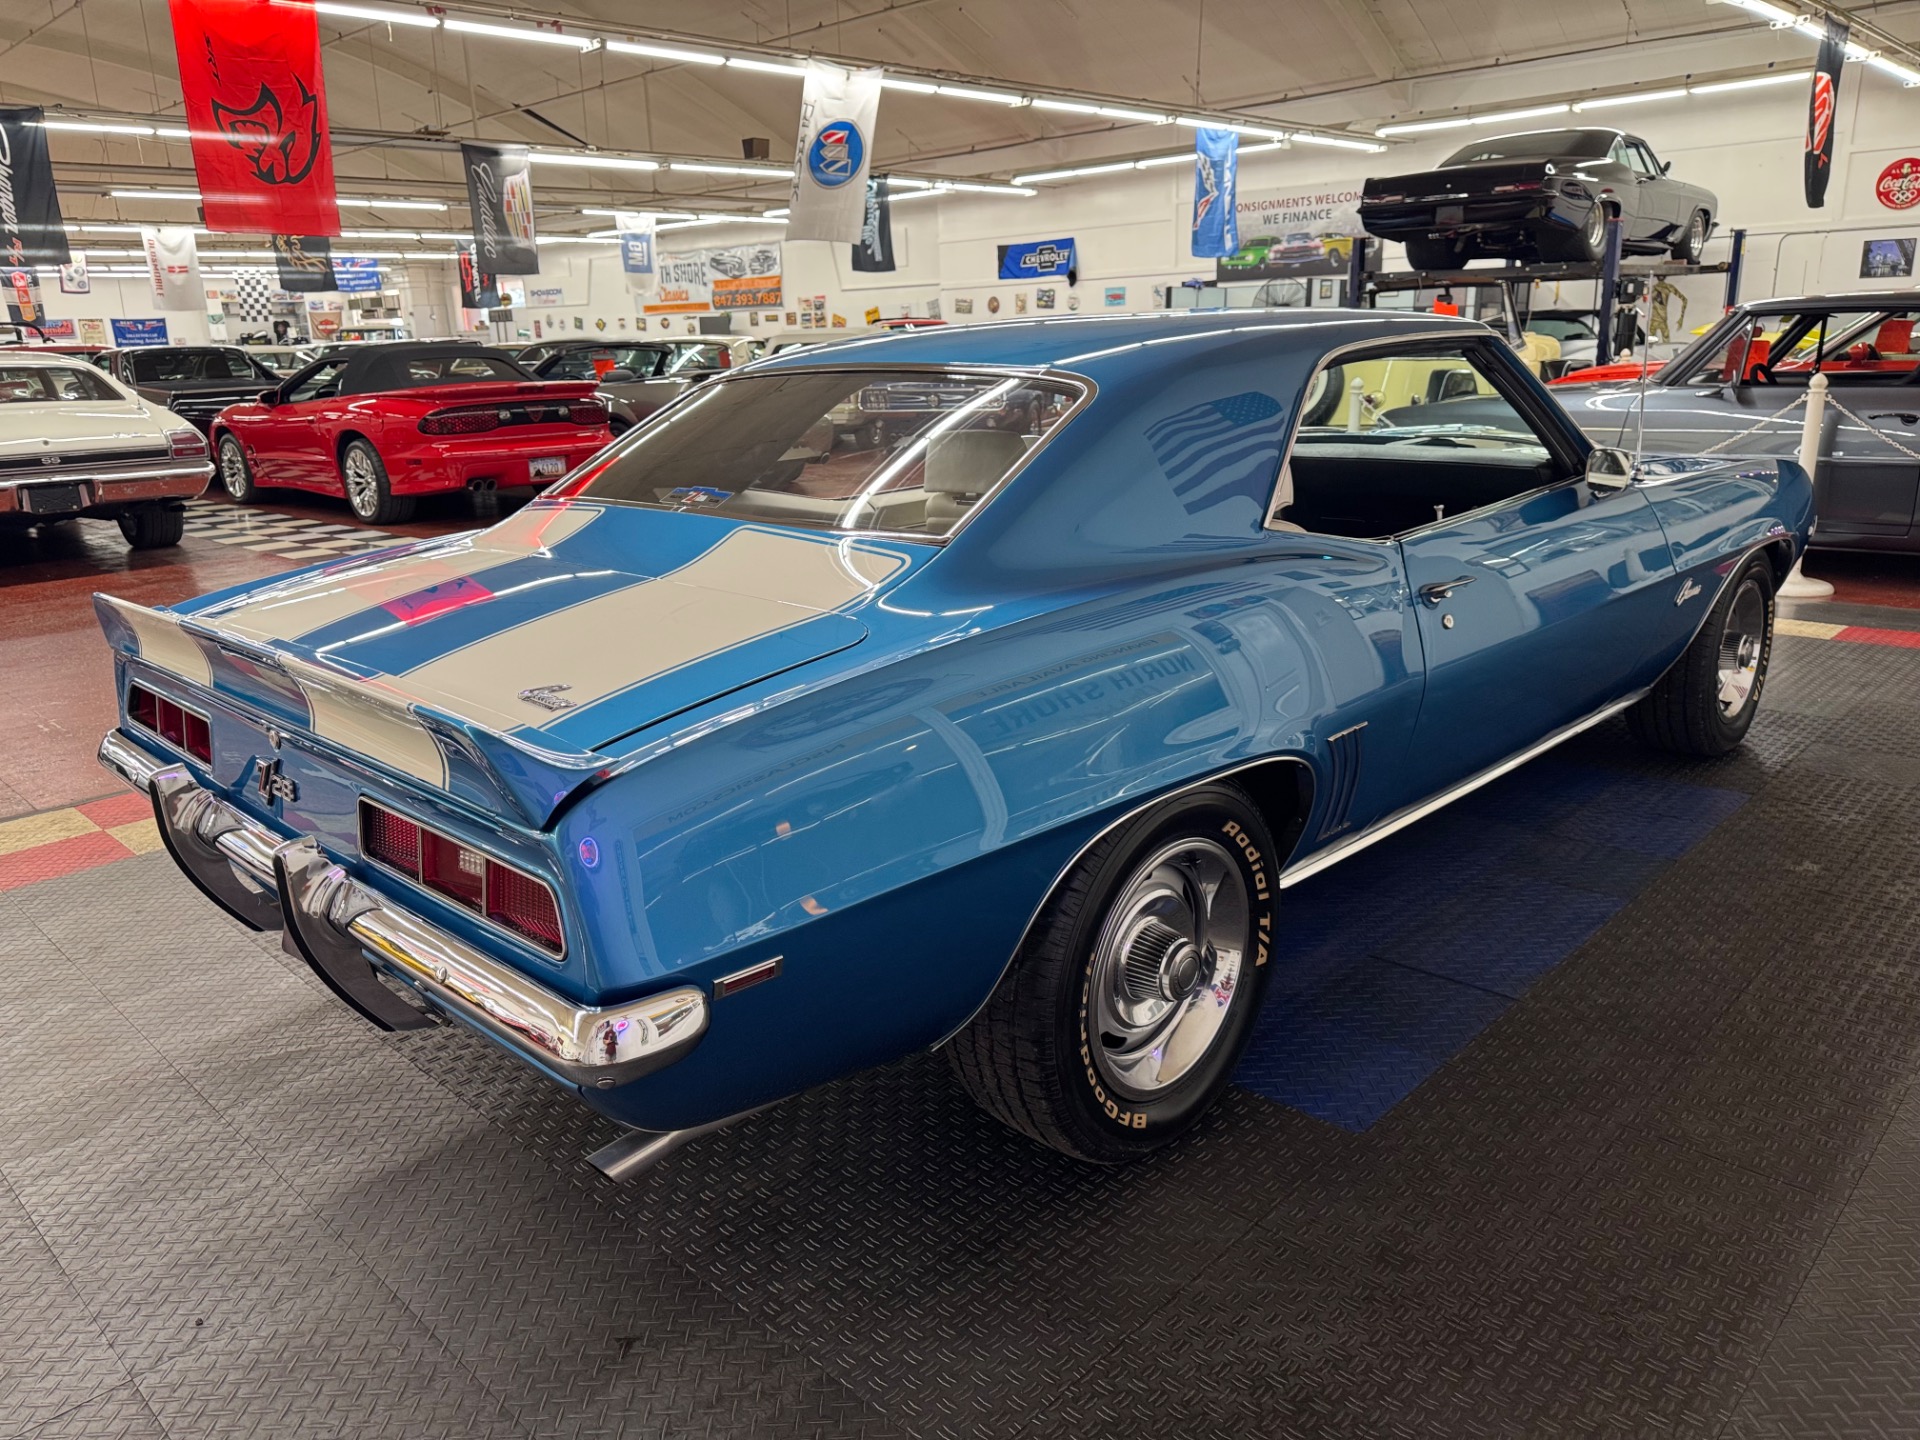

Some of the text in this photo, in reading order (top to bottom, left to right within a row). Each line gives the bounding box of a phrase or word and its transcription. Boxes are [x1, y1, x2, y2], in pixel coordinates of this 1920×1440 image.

[471, 162, 497, 259] Cadillac
[1236, 190, 1363, 213] ONSIGNMENTS WELCOM
[1262, 208, 1333, 225] WE FINANCE
[7, 236, 25, 267] R/T
[1025, 250, 1069, 265] CHEVROLET
[147, 239, 165, 298] OLDSMOBILE
[673, 262, 708, 287] SHORE
[713, 291, 782, 307] 847.393.7887
[41, 456, 61, 465] SS
[1221, 819, 1271, 967] Radial T/A
[1079, 952, 1147, 1129] BFGoodrich
